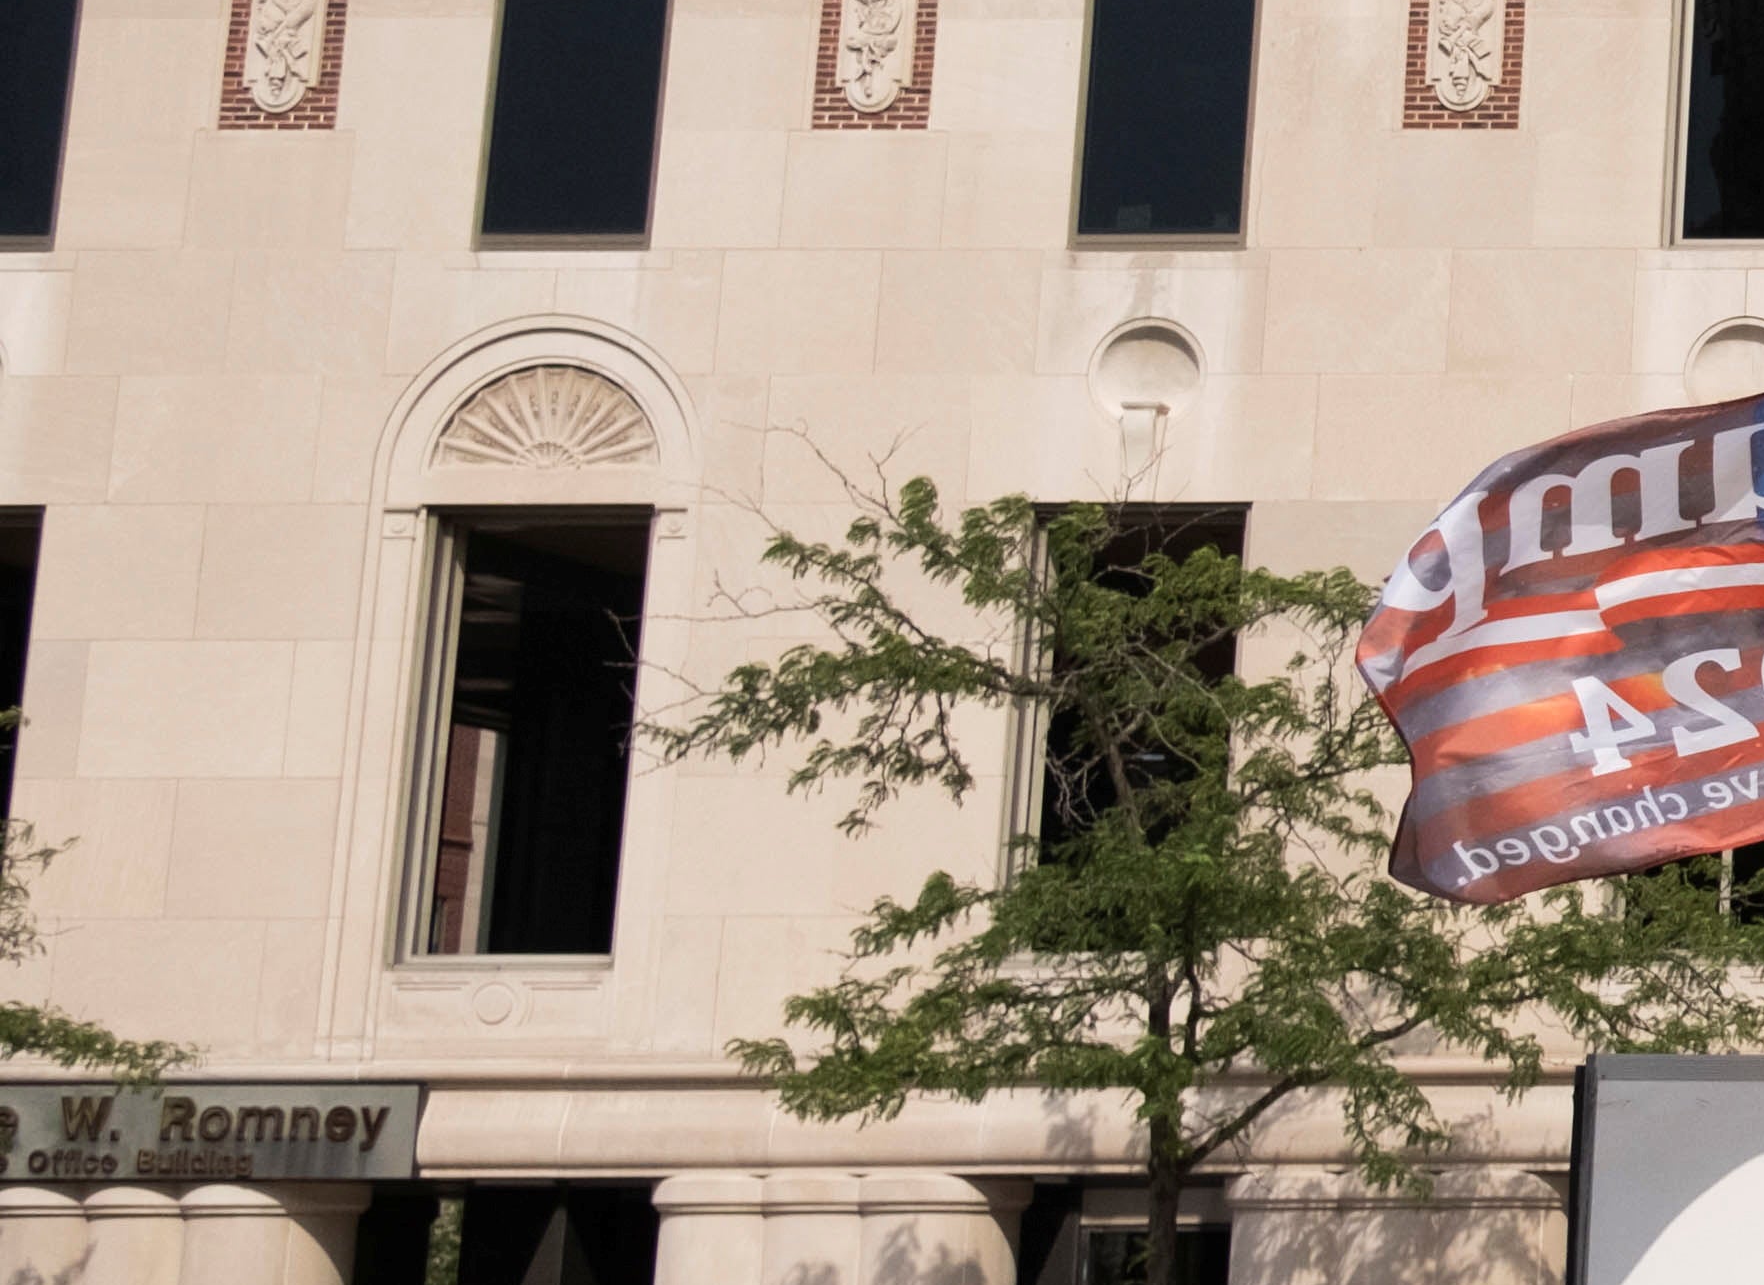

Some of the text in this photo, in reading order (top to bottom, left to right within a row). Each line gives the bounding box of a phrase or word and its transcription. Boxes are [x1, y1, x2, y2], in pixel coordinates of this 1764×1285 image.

[61, 1096, 121, 1142] W.
[159, 1096, 391, 1152] Romney
[28, 1149, 118, 1175] Office
[136, 1149, 254, 1178] Building
